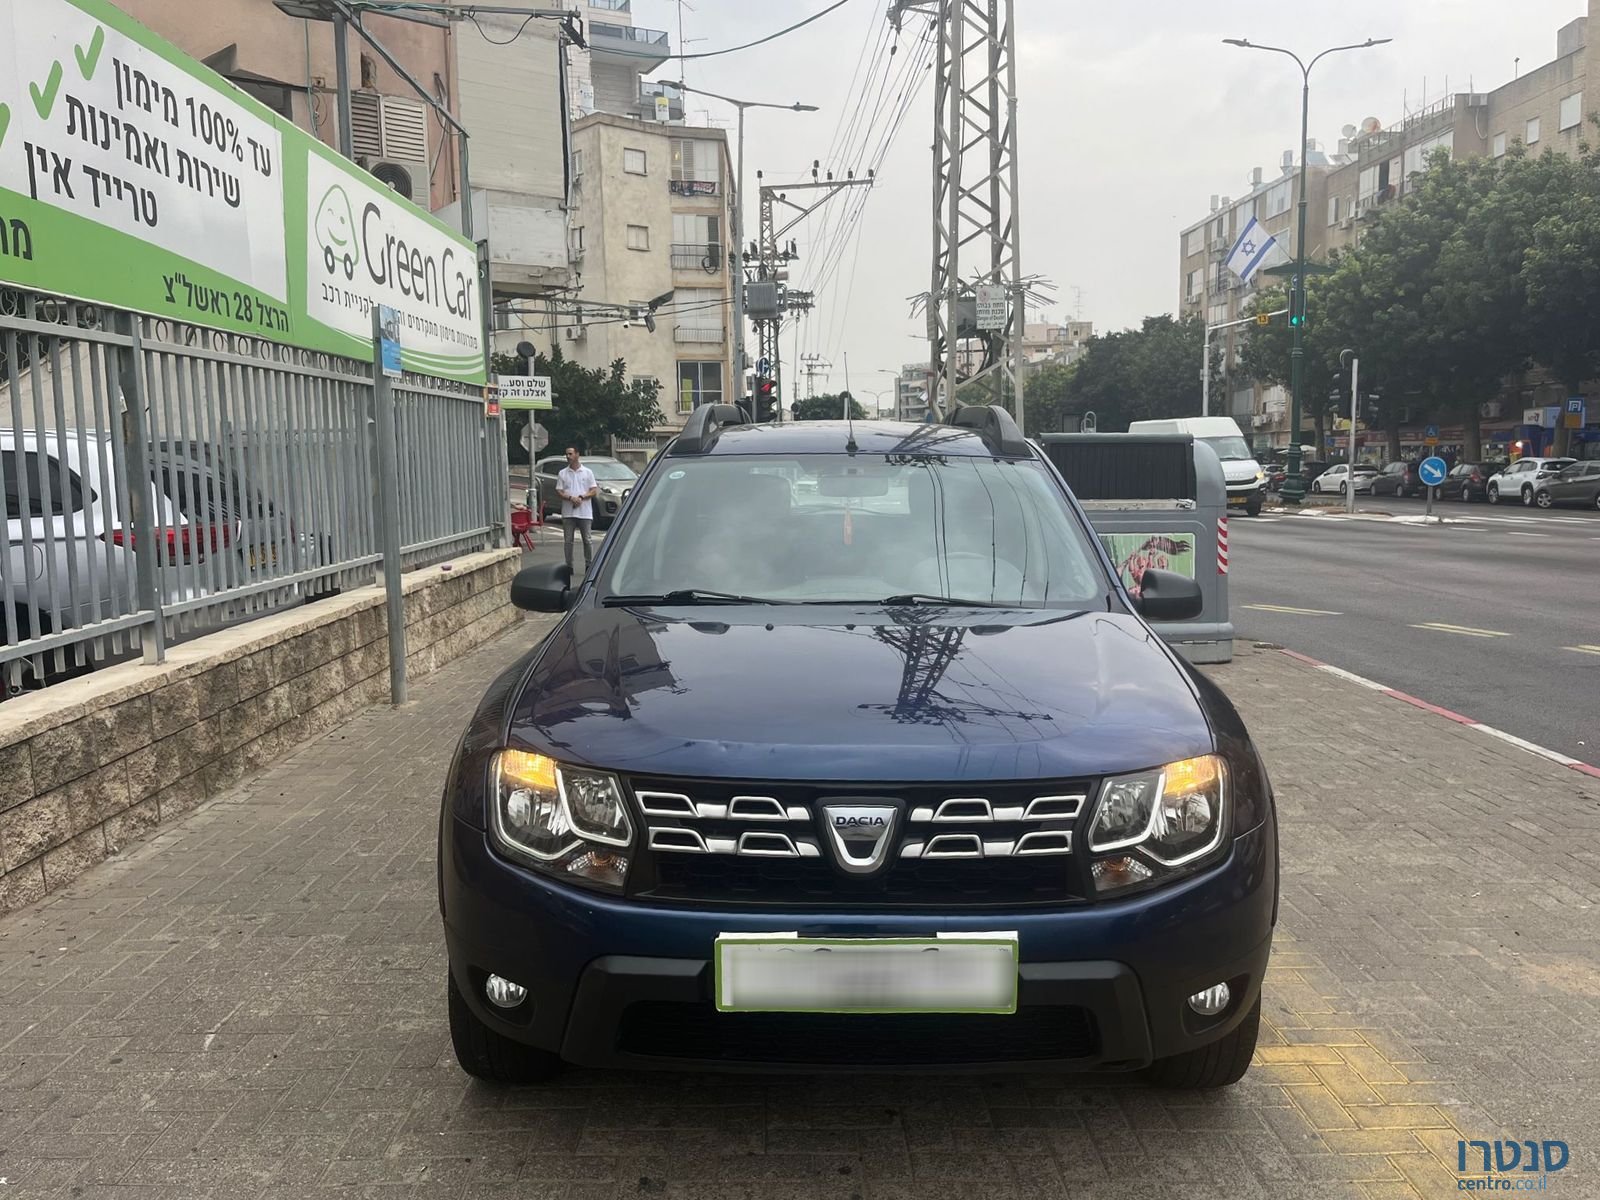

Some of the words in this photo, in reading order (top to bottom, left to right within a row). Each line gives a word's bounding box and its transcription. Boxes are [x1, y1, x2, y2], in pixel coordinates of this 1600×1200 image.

[112, 56, 179, 128] מימון
[65, 93, 171, 178] ואמינות
[185, 97, 244, 163] 100%
[23, 141, 76, 200] אין
[246, 137, 272, 177] עד
[82, 164, 158, 228] טרייד
[176, 148, 241, 208] שירות
[362, 202, 439, 308] Green
[442, 247, 473, 321] Car
[233, 291, 253, 323] 28
[321, 282, 341, 305] רכב
[255, 296, 289, 333] הרצל
[407, 313, 438, 338] מתקדמים
[510, 389, 521, 397] זה
[522, 388, 547, 398] אצלנו
[526, 379, 546, 388] שלם
[835, 816, 885, 826] DACIA
